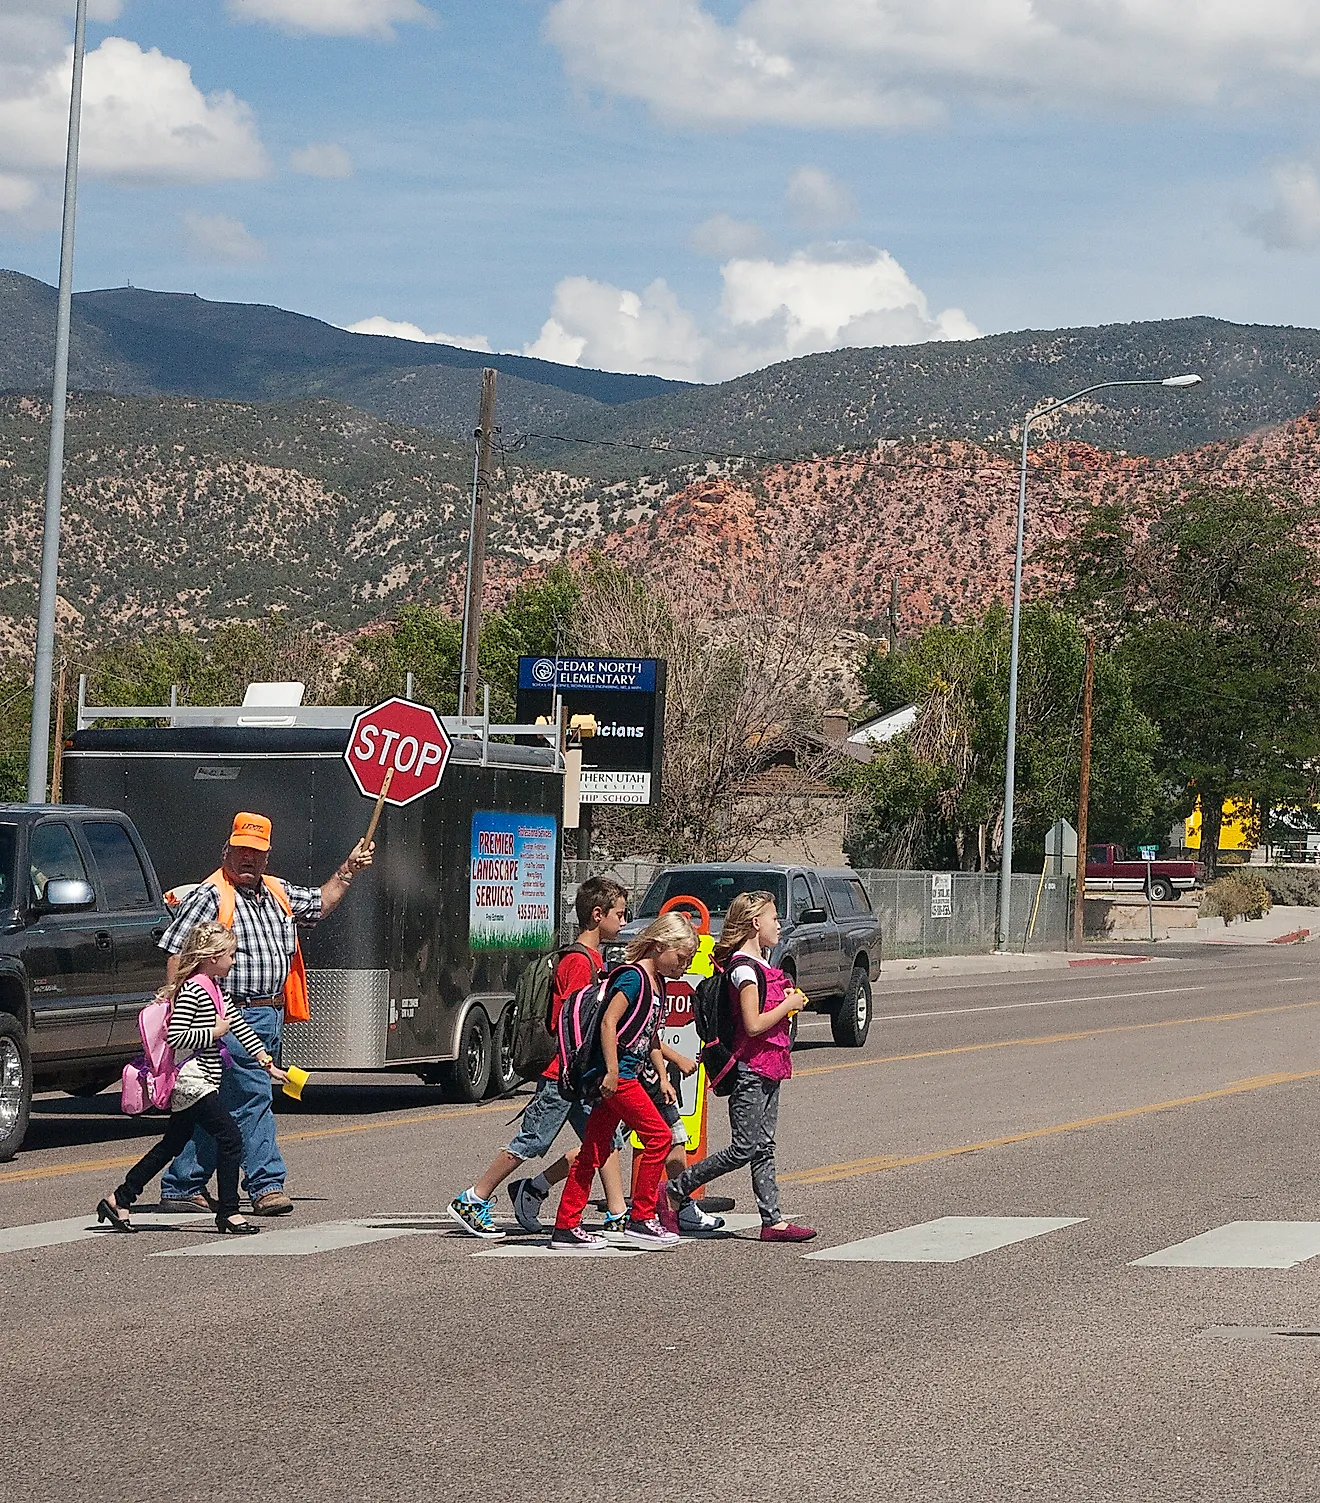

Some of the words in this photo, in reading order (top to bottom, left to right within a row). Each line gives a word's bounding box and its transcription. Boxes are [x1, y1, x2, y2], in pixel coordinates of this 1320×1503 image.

[556, 660, 595, 672] CEDAR
[598, 661, 642, 674] NORTH
[560, 672, 636, 685] ELEMENTARY
[354, 724, 442, 777] STOP
[580, 772, 613, 783] THERN
[616, 773, 645, 784] UTAH
[602, 794, 645, 803] SCHOOL
[479, 832, 514, 855] PREMIER
[472, 858, 519, 881] LANDSCAPE
[475, 885, 514, 907] SERVICES
